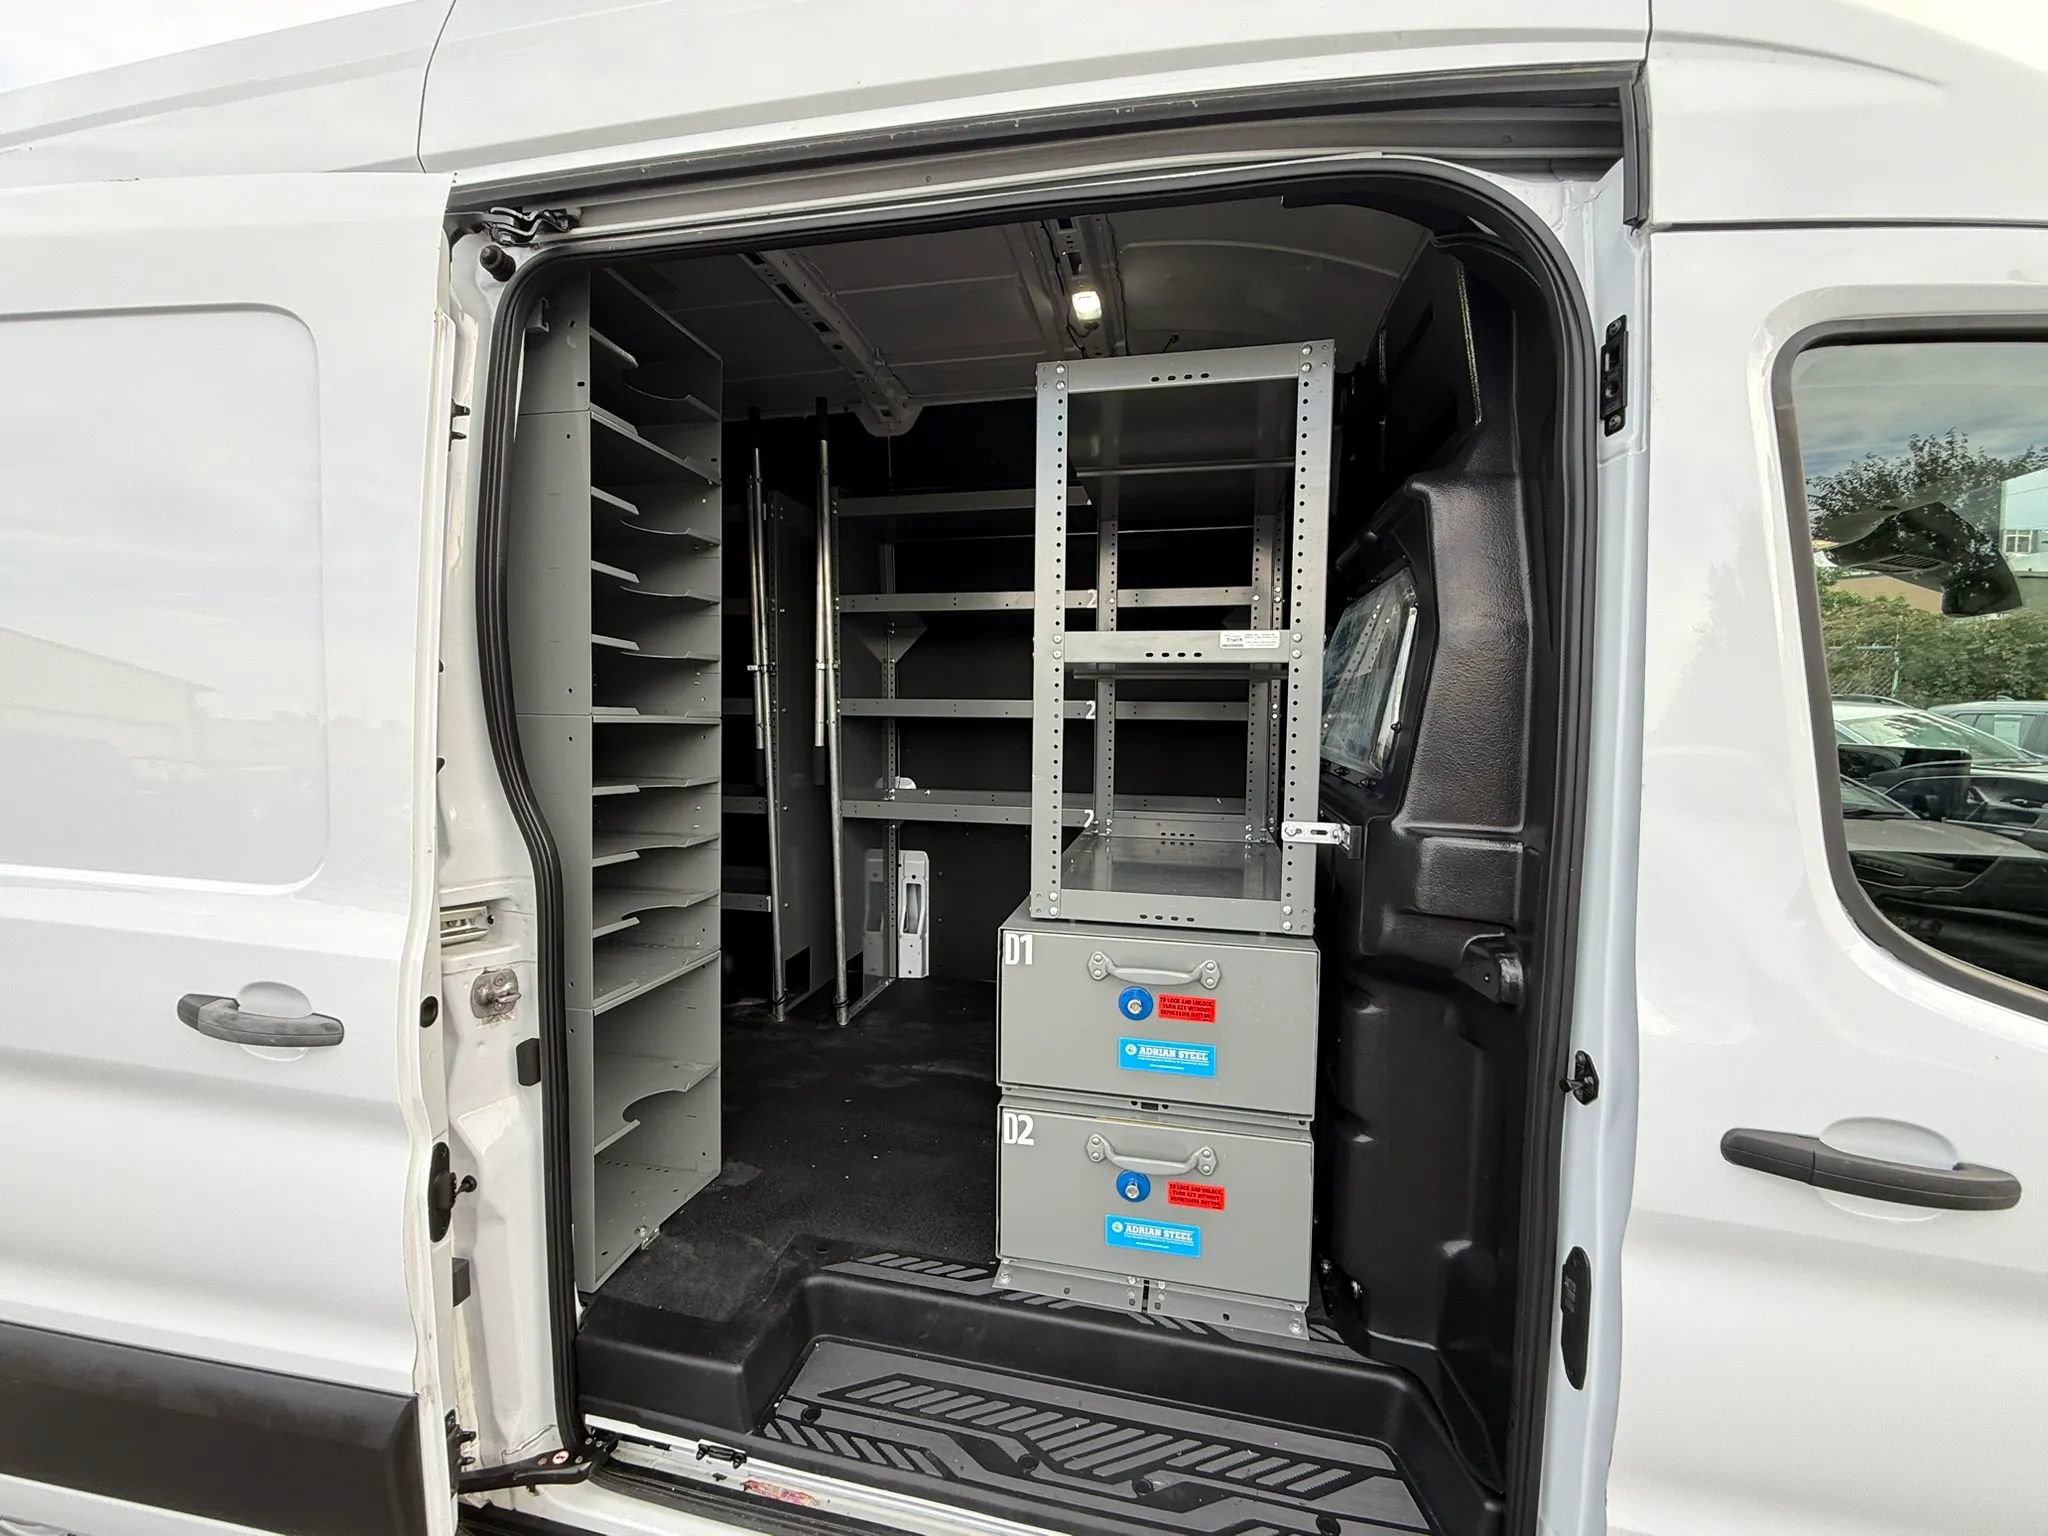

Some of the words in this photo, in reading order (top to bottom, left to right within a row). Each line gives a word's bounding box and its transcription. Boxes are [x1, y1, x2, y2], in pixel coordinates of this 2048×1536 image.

[1005, 933, 1033, 965] D1
[1138, 1046, 1177, 1058] ADRIAN
[1177, 1050, 1209, 1061] STEEL
[1003, 1112, 1034, 1146] D2
[1125, 1224, 1162, 1237] ADRIAN
[1163, 1229, 1193, 1241] STEEL
